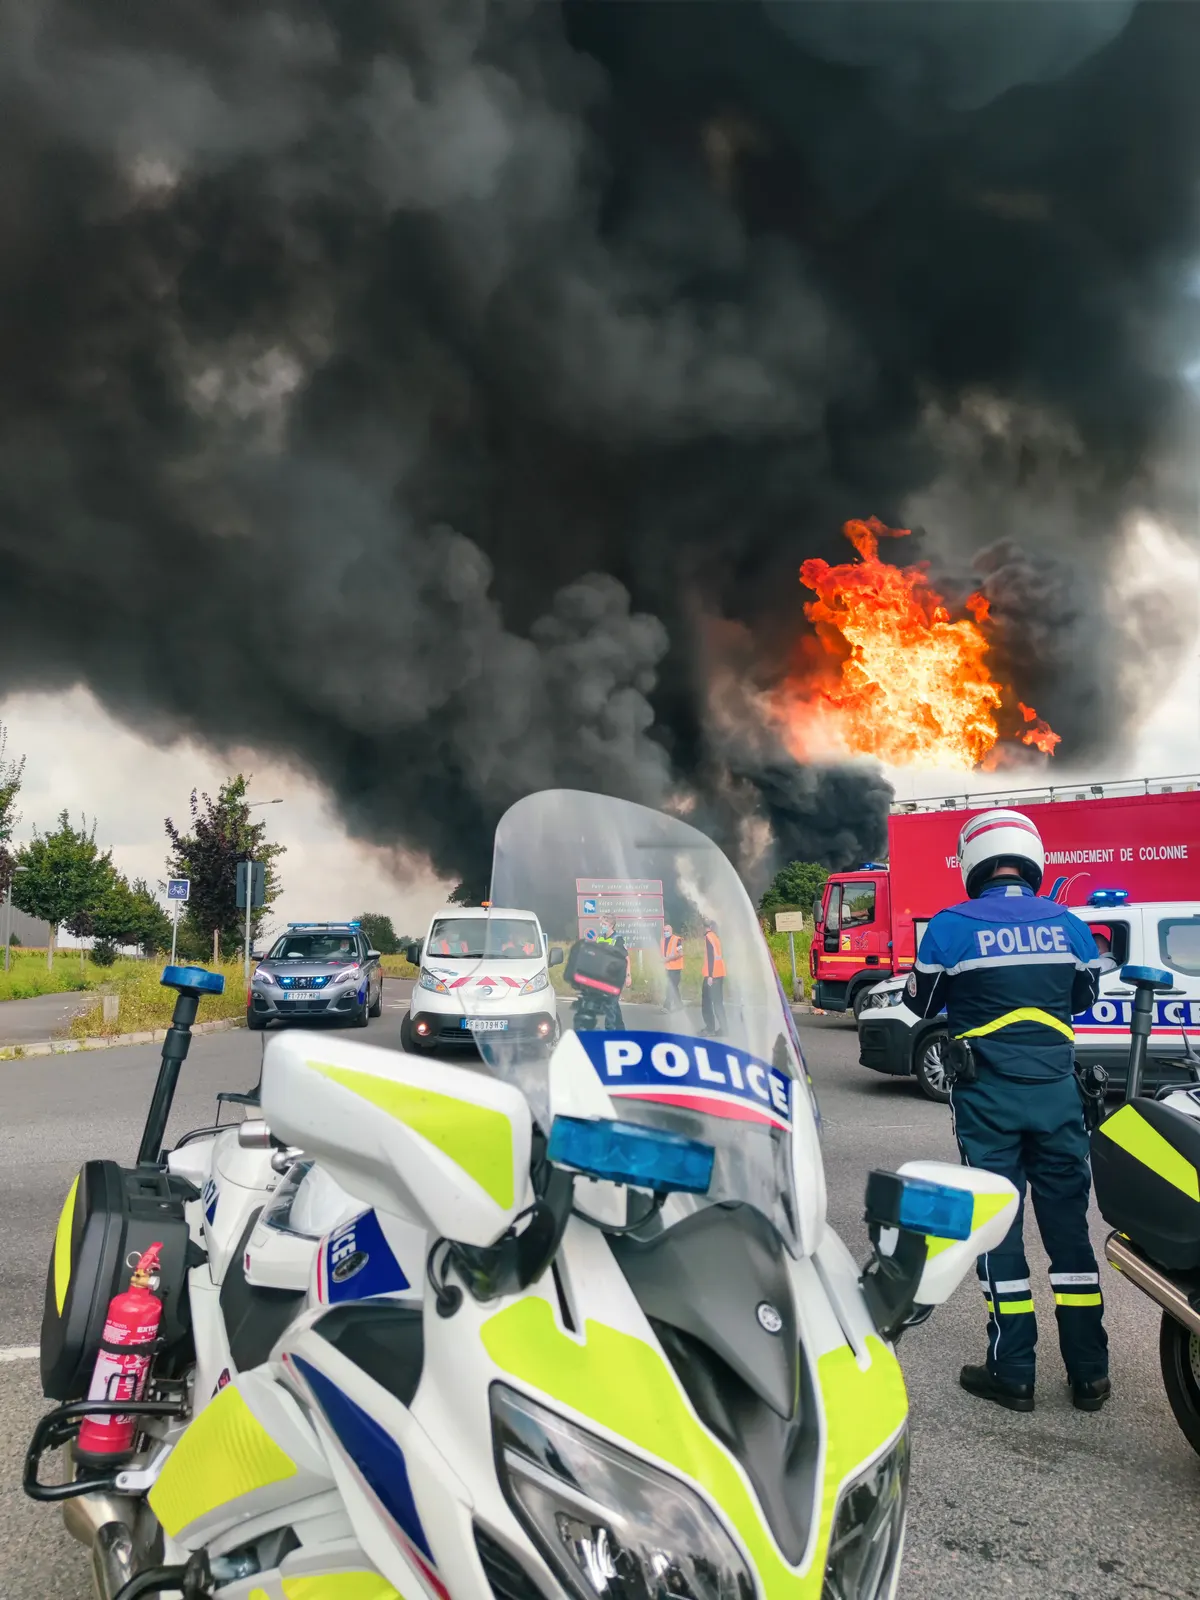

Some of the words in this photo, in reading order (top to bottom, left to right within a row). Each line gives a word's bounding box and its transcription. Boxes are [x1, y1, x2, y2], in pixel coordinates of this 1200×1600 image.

[1044, 848, 1115, 865] OMMANDEMENT
[1120, 847, 1134, 862] DE
[1139, 844, 1189, 861] COLONNE
[977, 926, 1067, 956] POLICE
[603, 1040, 790, 1115] POLICE
